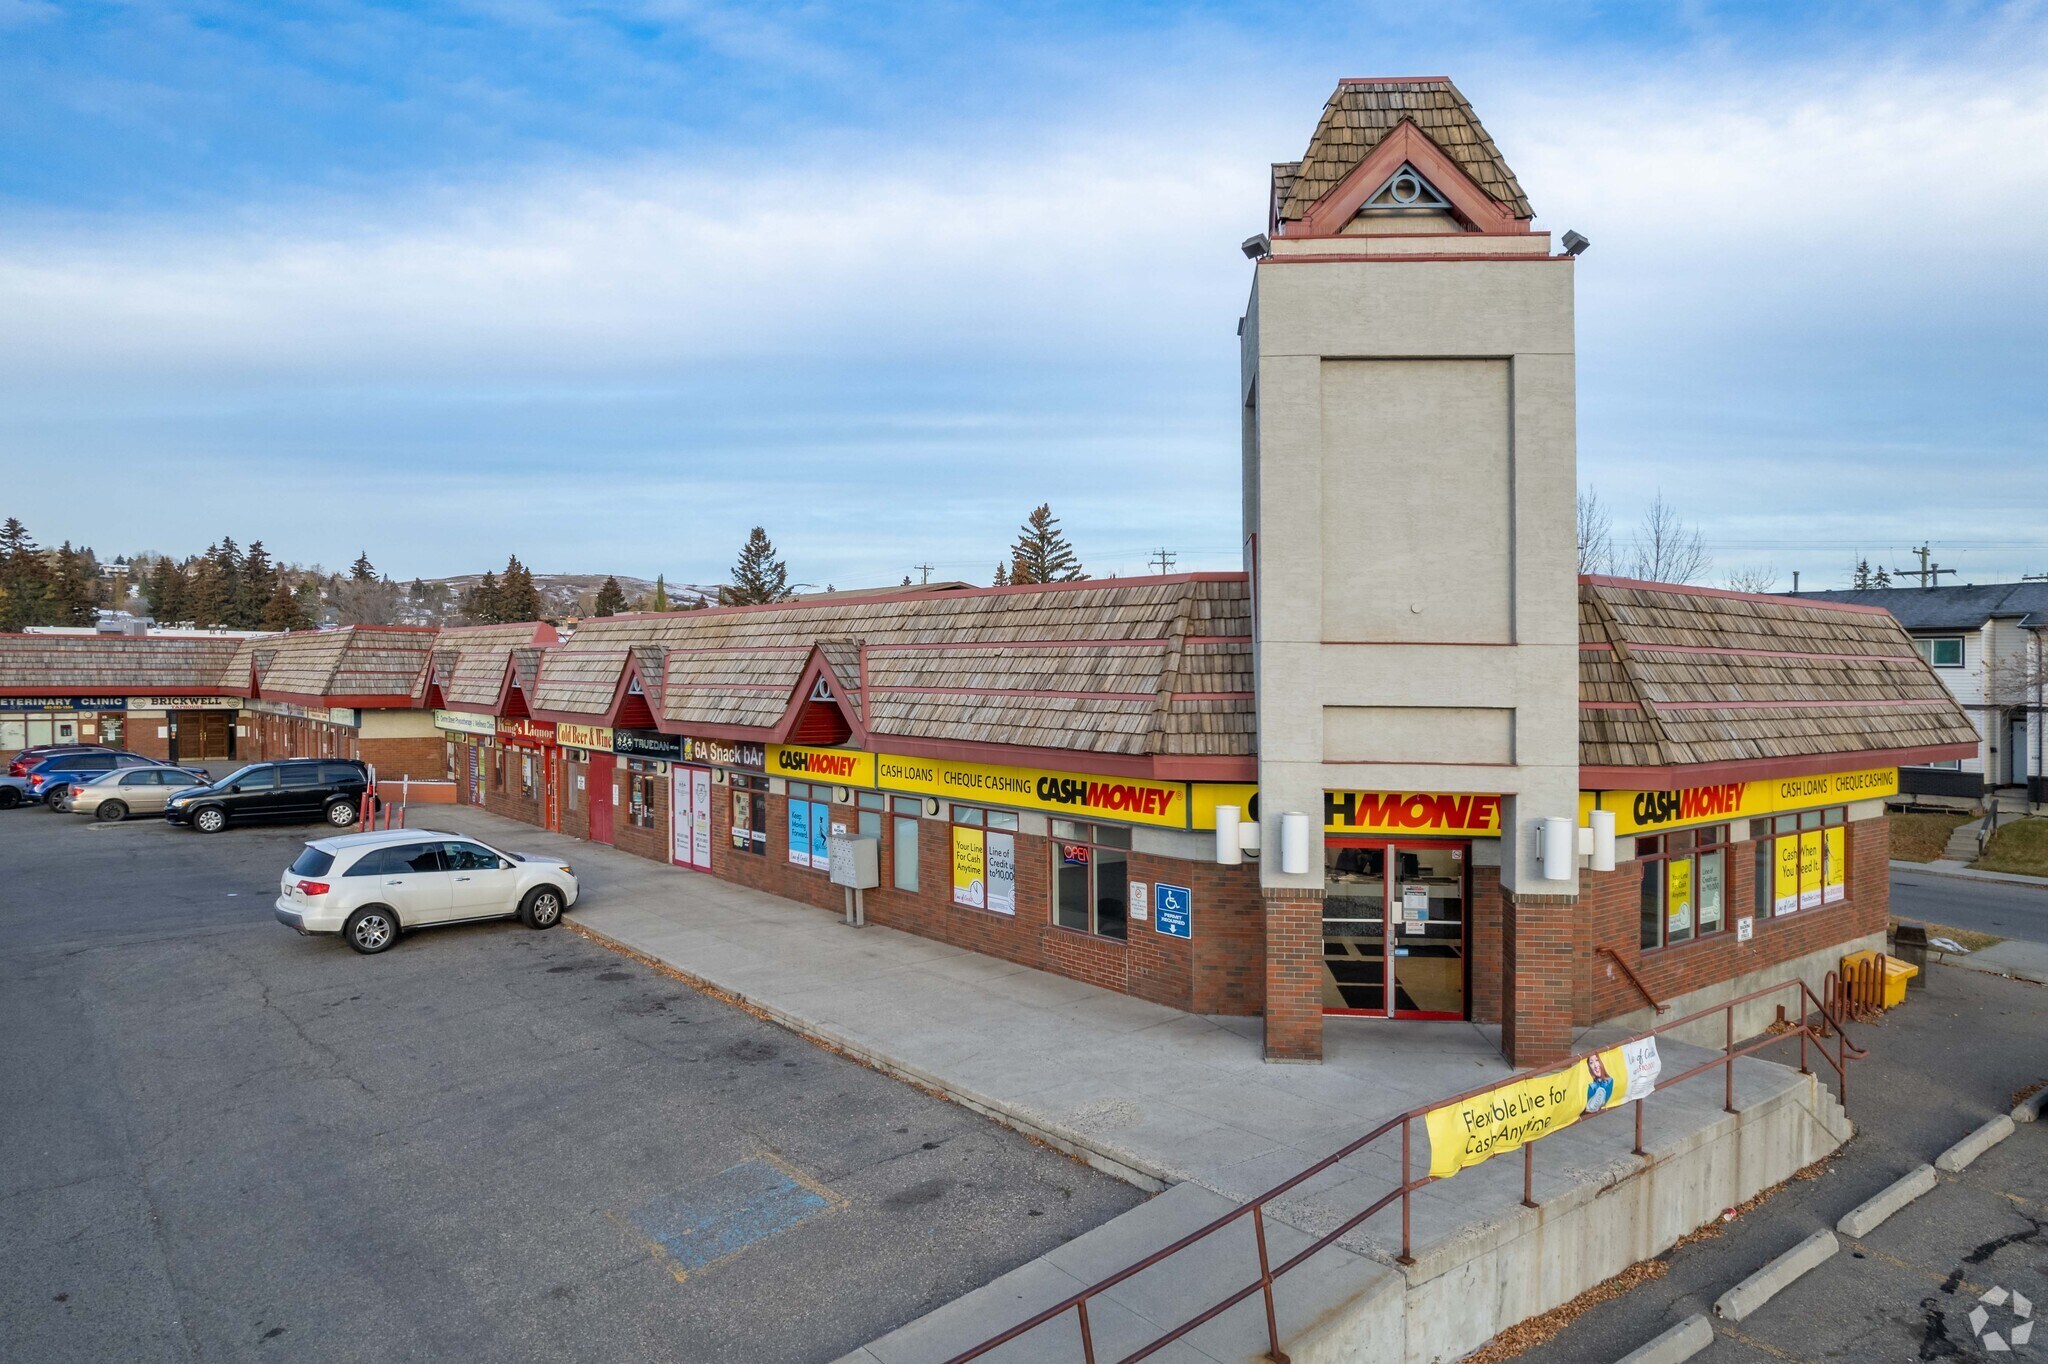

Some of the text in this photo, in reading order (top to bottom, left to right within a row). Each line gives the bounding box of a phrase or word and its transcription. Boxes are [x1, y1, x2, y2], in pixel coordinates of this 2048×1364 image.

[0, 698, 72, 706] ETERINARY
[151, 697, 221, 705] BRICKWELL
[497, 717, 555, 738] King's Liquor
[557, 723, 571, 742] Cold
[572, 726, 588, 743] Beer
[589, 727, 595, 746] &
[595, 728, 612, 749] Wine
[633, 738, 670, 752] TRUEDAN
[694, 741, 708, 759] 6A
[710, 742, 741, 763] Snack
[779, 750, 857, 777] CASHMONEY
[880, 764, 903, 779] CASH
[904, 767, 933, 782] LOANS
[943, 771, 983, 788] CHEQUE
[984, 775, 1032, 794] CASHING
[1780, 771, 1893, 799] CASH LOANS CHEQUE CASHING
[956, 841, 983, 854] Your Line
[989, 846, 1010, 859] Line of
[1064, 845, 1089, 862] OPEN
[1782, 847, 1798, 861] Cash
[956, 851, 981, 864] For Cash
[989, 857, 1008, 869] Credit
[956, 862, 981, 875] Anytime
[1782, 864, 1795, 878] You
[1796, 860, 1812, 875] eed
[1160, 916, 1186, 926] REQUIRED
[1163, 912, 1183, 920] PERMIT
[1463, 1085, 1567, 1133] Flexible Line for
[1465, 1129, 1498, 1155] Cash
